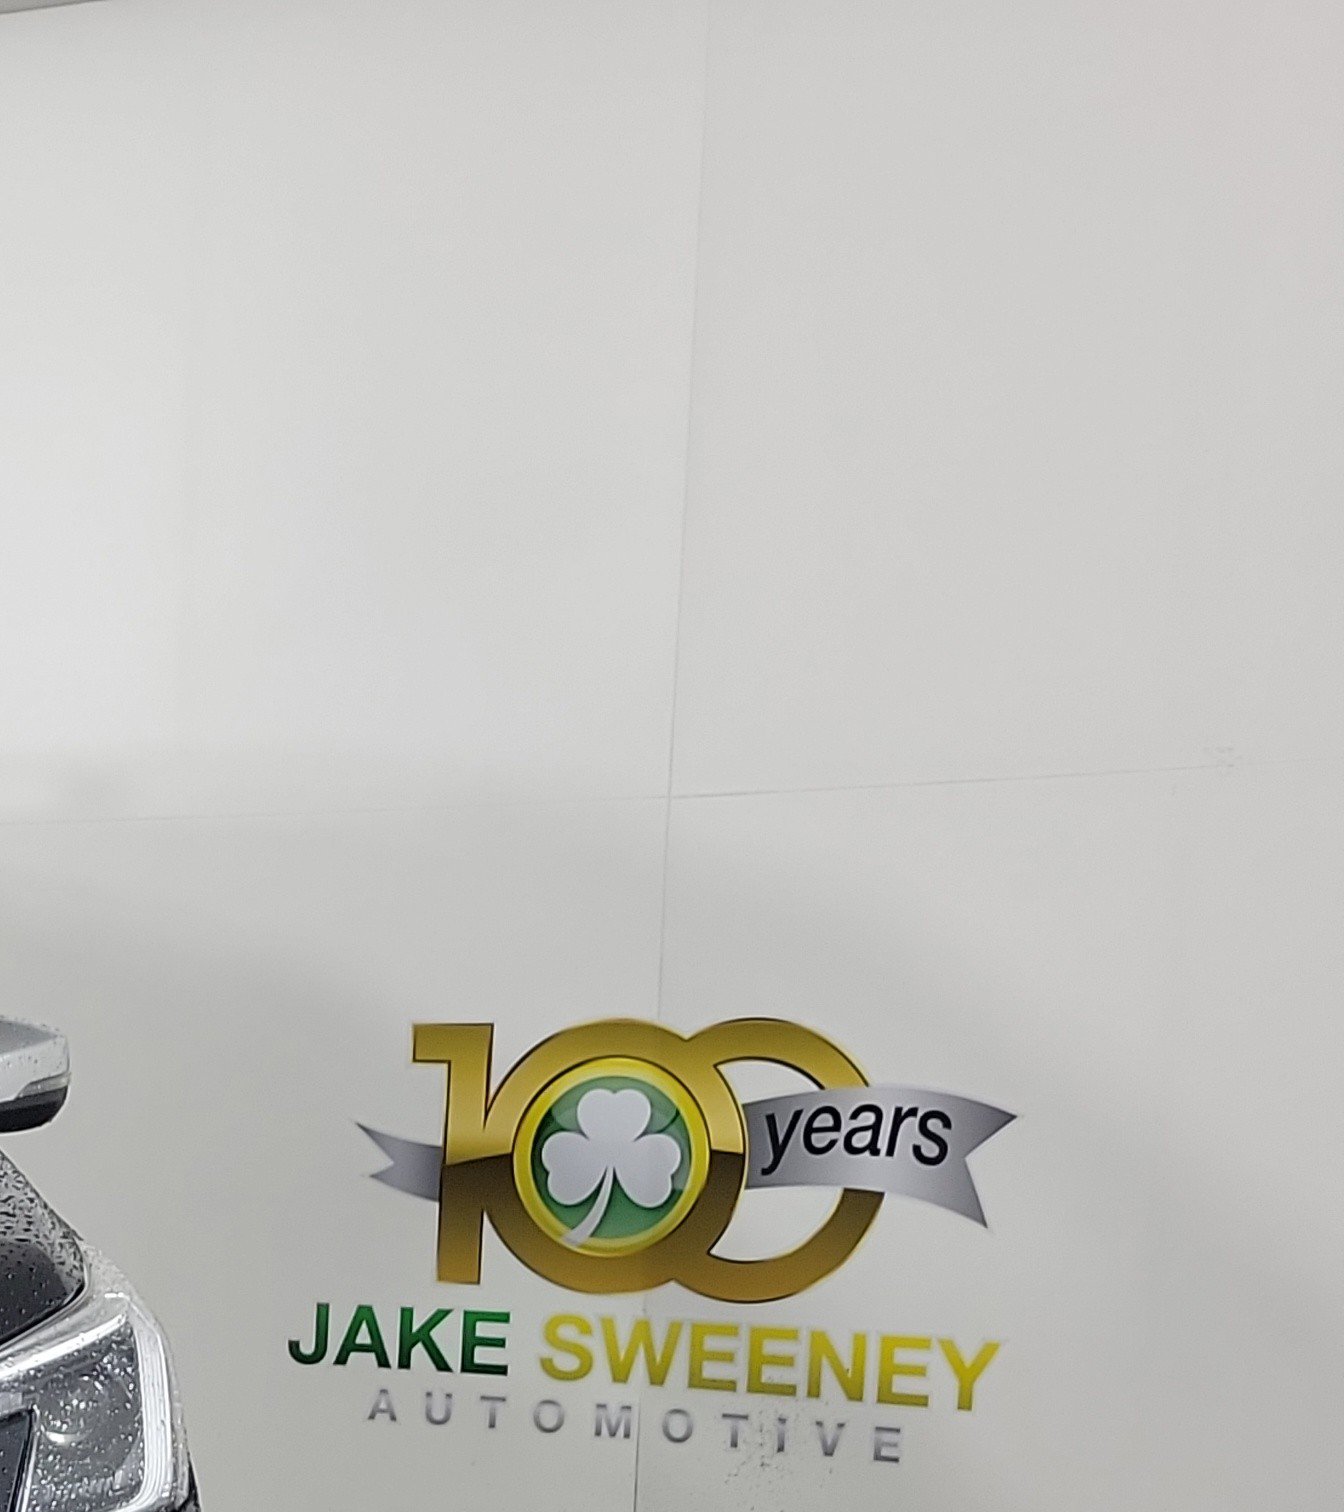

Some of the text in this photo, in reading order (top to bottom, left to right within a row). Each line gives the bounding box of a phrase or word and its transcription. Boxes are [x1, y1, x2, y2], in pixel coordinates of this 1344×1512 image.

[412, 1016, 952, 1304] 100 years
[287, 1302, 1003, 1412] JAKE SWEENEY
[367, 1387, 902, 1464] AUTOMOTIVE
